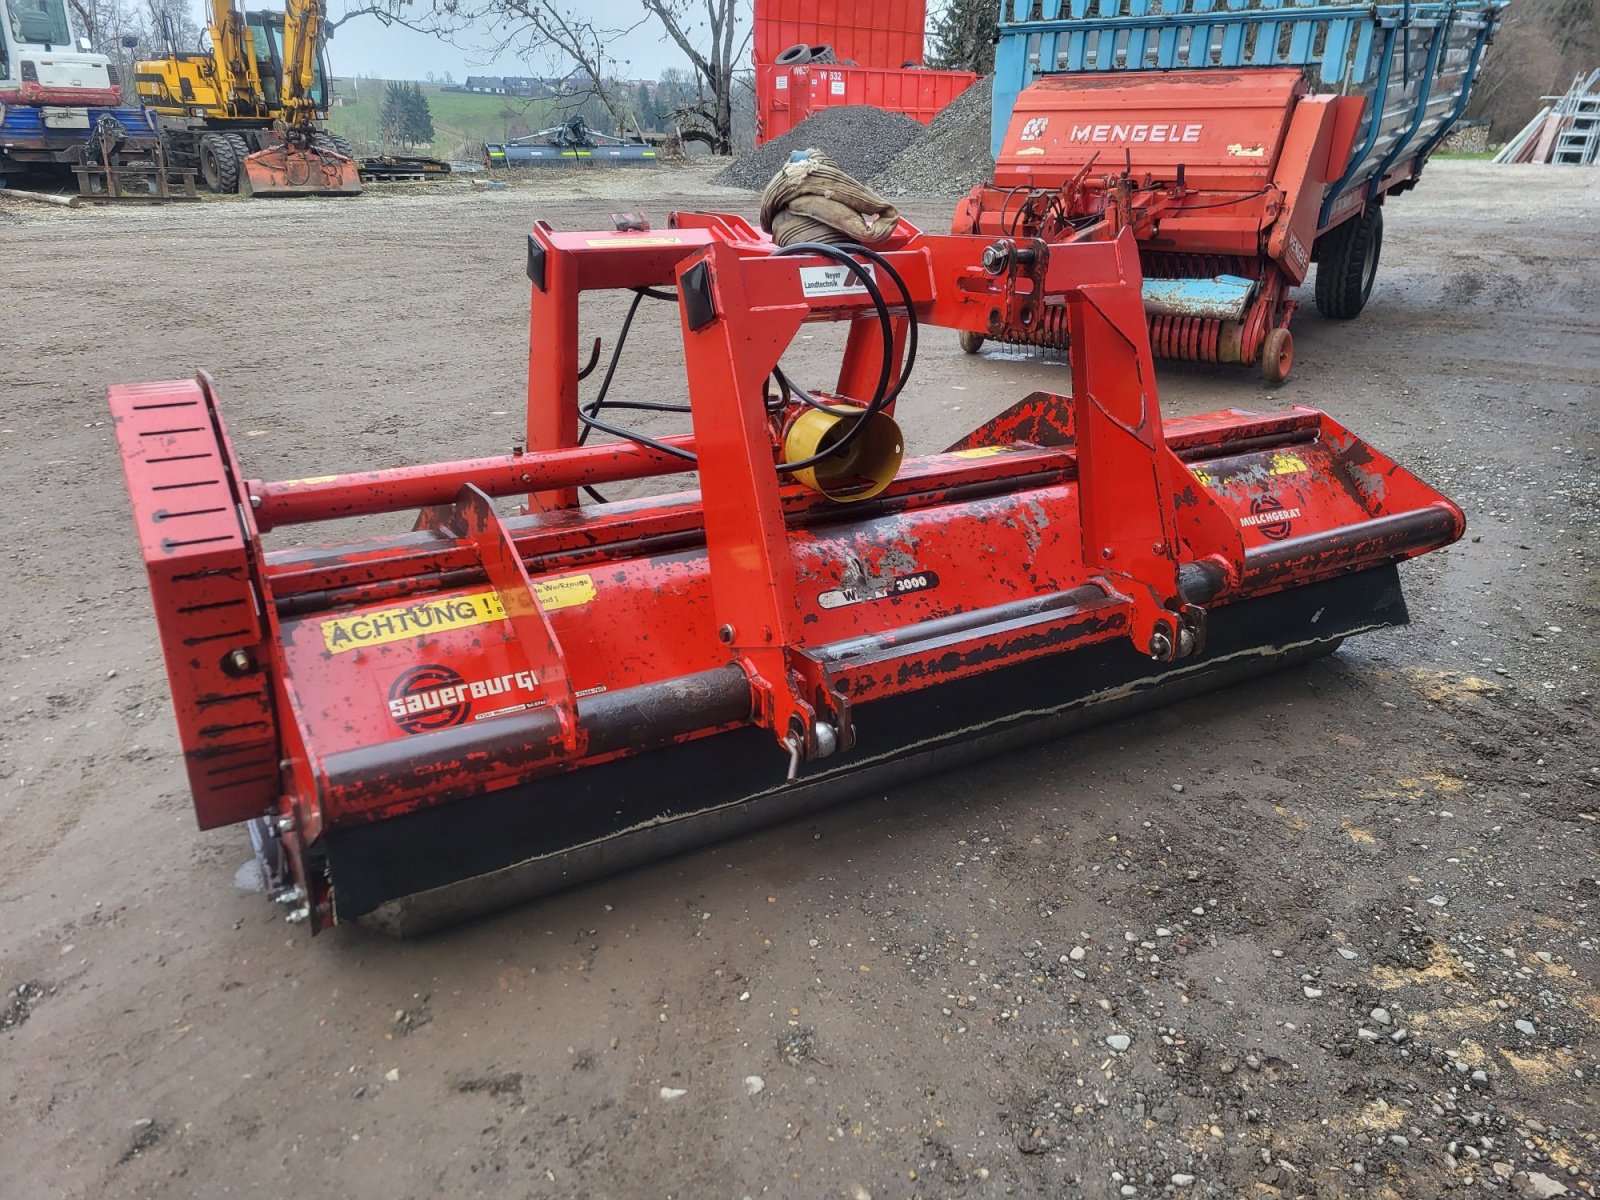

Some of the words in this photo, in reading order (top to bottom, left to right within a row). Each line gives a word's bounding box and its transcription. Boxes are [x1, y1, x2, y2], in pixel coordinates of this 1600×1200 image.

[820, 71, 828, 80] W
[1070, 124, 1203, 142] MENGELE
[824, 271, 841, 280] Neyer
[804, 280, 839, 289] Landtechnik
[543, 579, 589, 592] Werkzeuge
[896, 576, 928, 592] 3000
[332, 601, 478, 646] ACHTUNG
